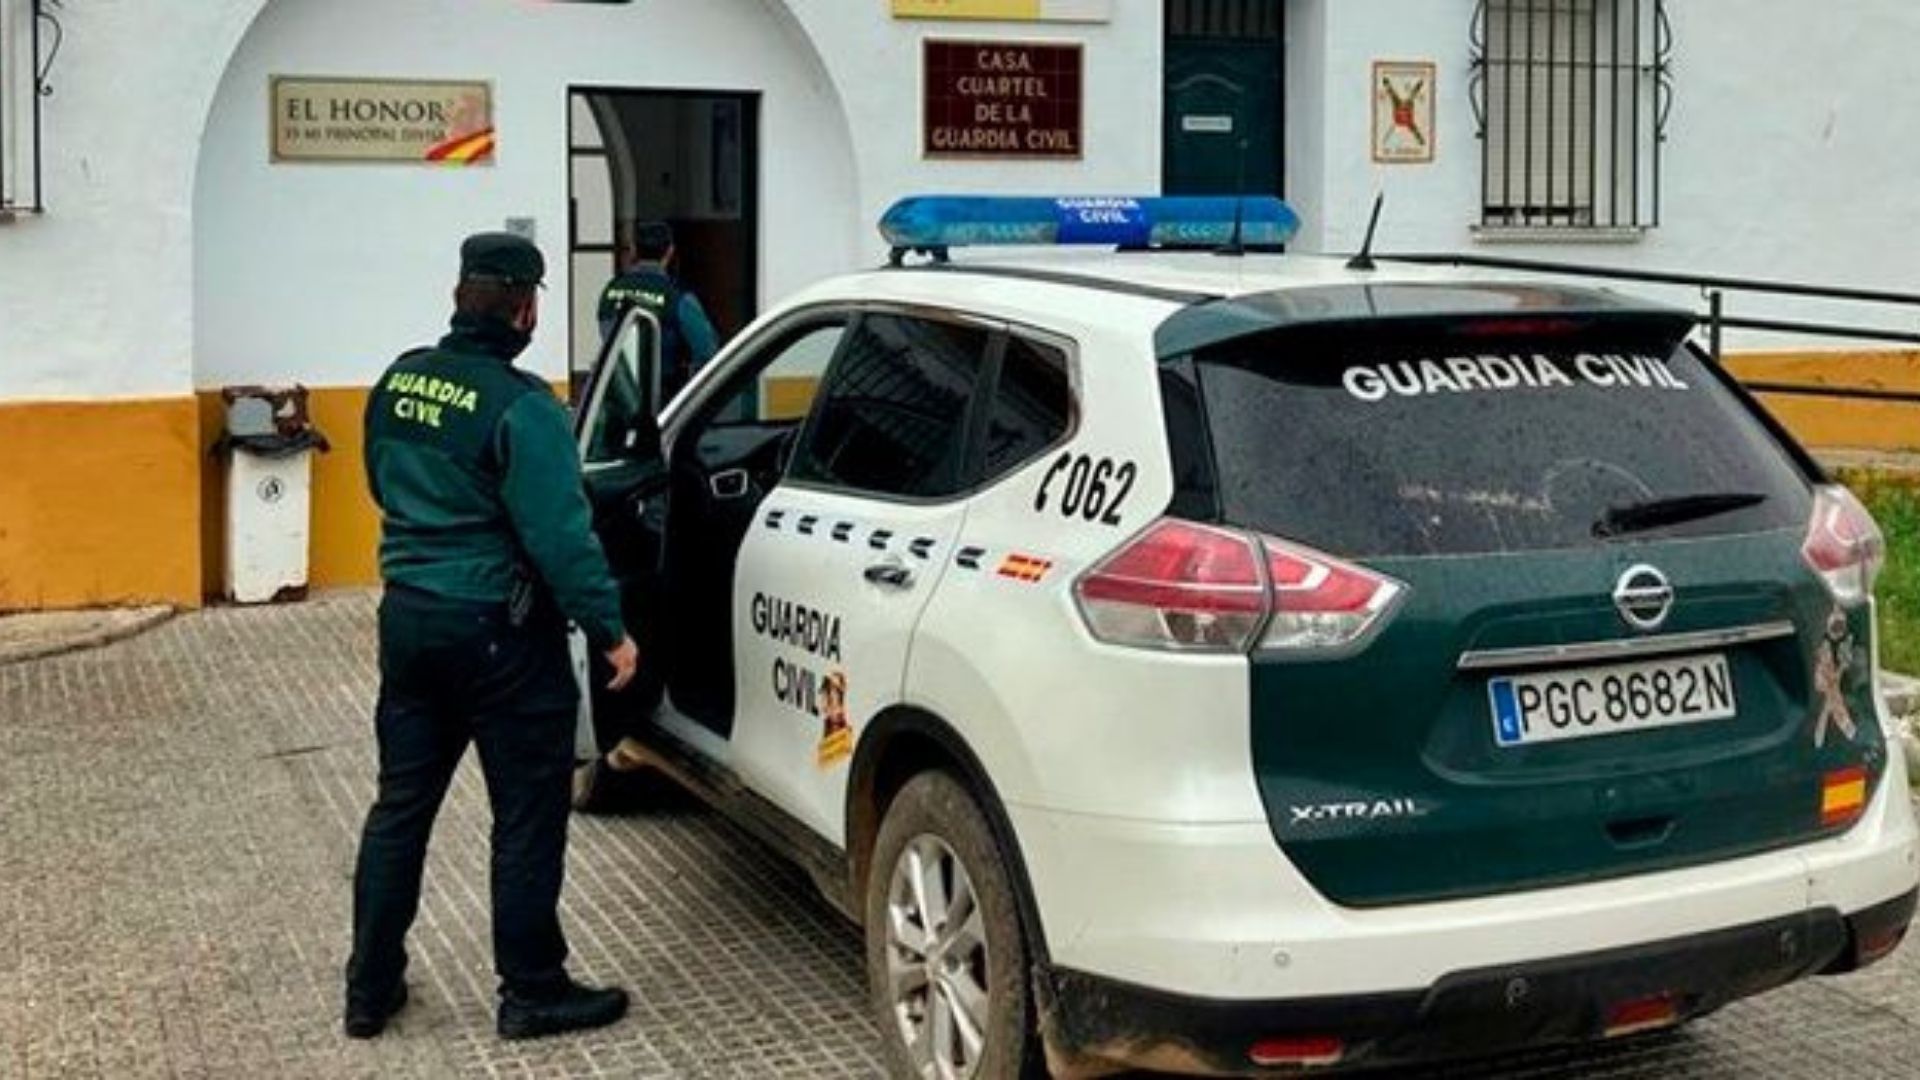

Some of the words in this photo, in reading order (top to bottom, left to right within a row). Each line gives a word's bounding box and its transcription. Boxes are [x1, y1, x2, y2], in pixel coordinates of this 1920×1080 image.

[977, 51, 1031, 70] CASA
[956, 76, 1047, 97] CUARTEL
[286, 99, 318, 121] EL
[329, 98, 447, 121] HONOR
[974, 103, 1000, 122] DE
[1006, 104, 1031, 122] LA
[932, 127, 1020, 149] GUARDIA
[1026, 129, 1073, 149] CIVIL
[1080, 209, 1130, 223] CIVIL
[1342, 354, 1575, 401] GUARDIA
[1574, 353, 1689, 391] CIVIL
[386, 372, 477, 412] GUARDIA
[1061, 454, 1137, 526] 062
[752, 591, 841, 663] GUARDIA
[773, 656, 819, 716] CIVIL
[1290, 798, 1428, 825] X-TRAIL
